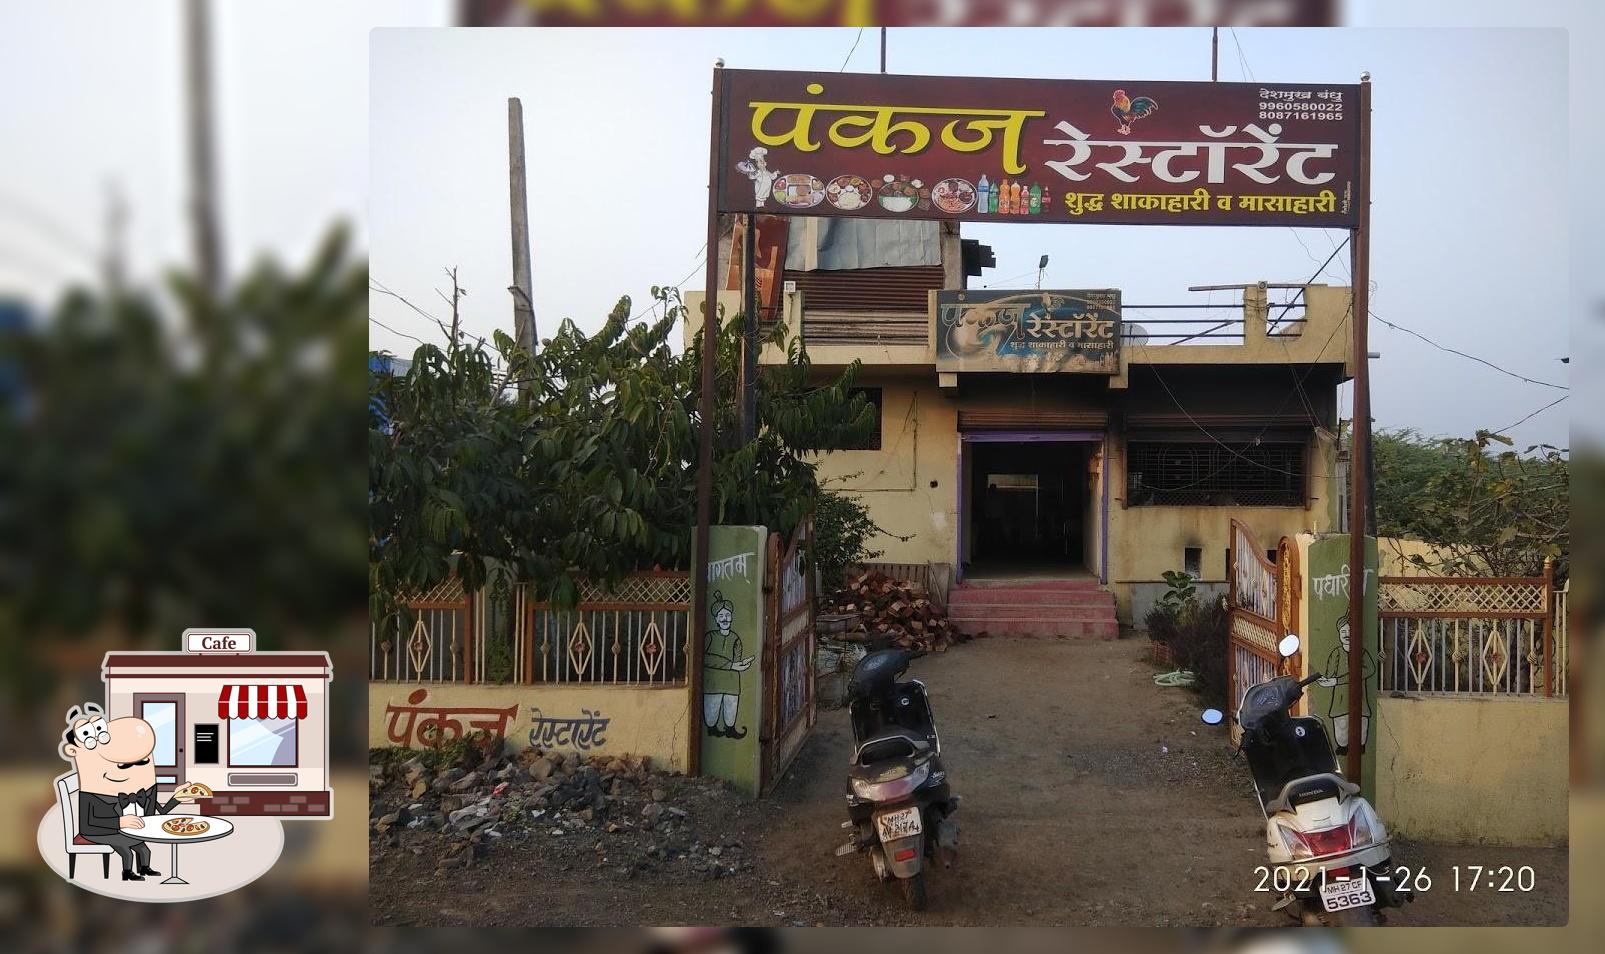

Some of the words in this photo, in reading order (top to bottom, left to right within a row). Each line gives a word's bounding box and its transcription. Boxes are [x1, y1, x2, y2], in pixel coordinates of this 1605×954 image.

[1259, 88, 1312, 101] देशमुख
[1259, 102, 1343, 112] 9960580022
[1259, 111, 1343, 121] 8087161965
[749, 83, 1046, 175] पंकज
[1044, 121, 1339, 185] रेस्टॉरेंट
[1065, 192, 1104, 215] शुद्ध
[1111, 188, 1210, 213] शाकाहारी
[1217, 195, 1231, 211] व
[1238, 189, 1337, 214] मासाहारी
[1326, 891, 1372, 910] 5363
